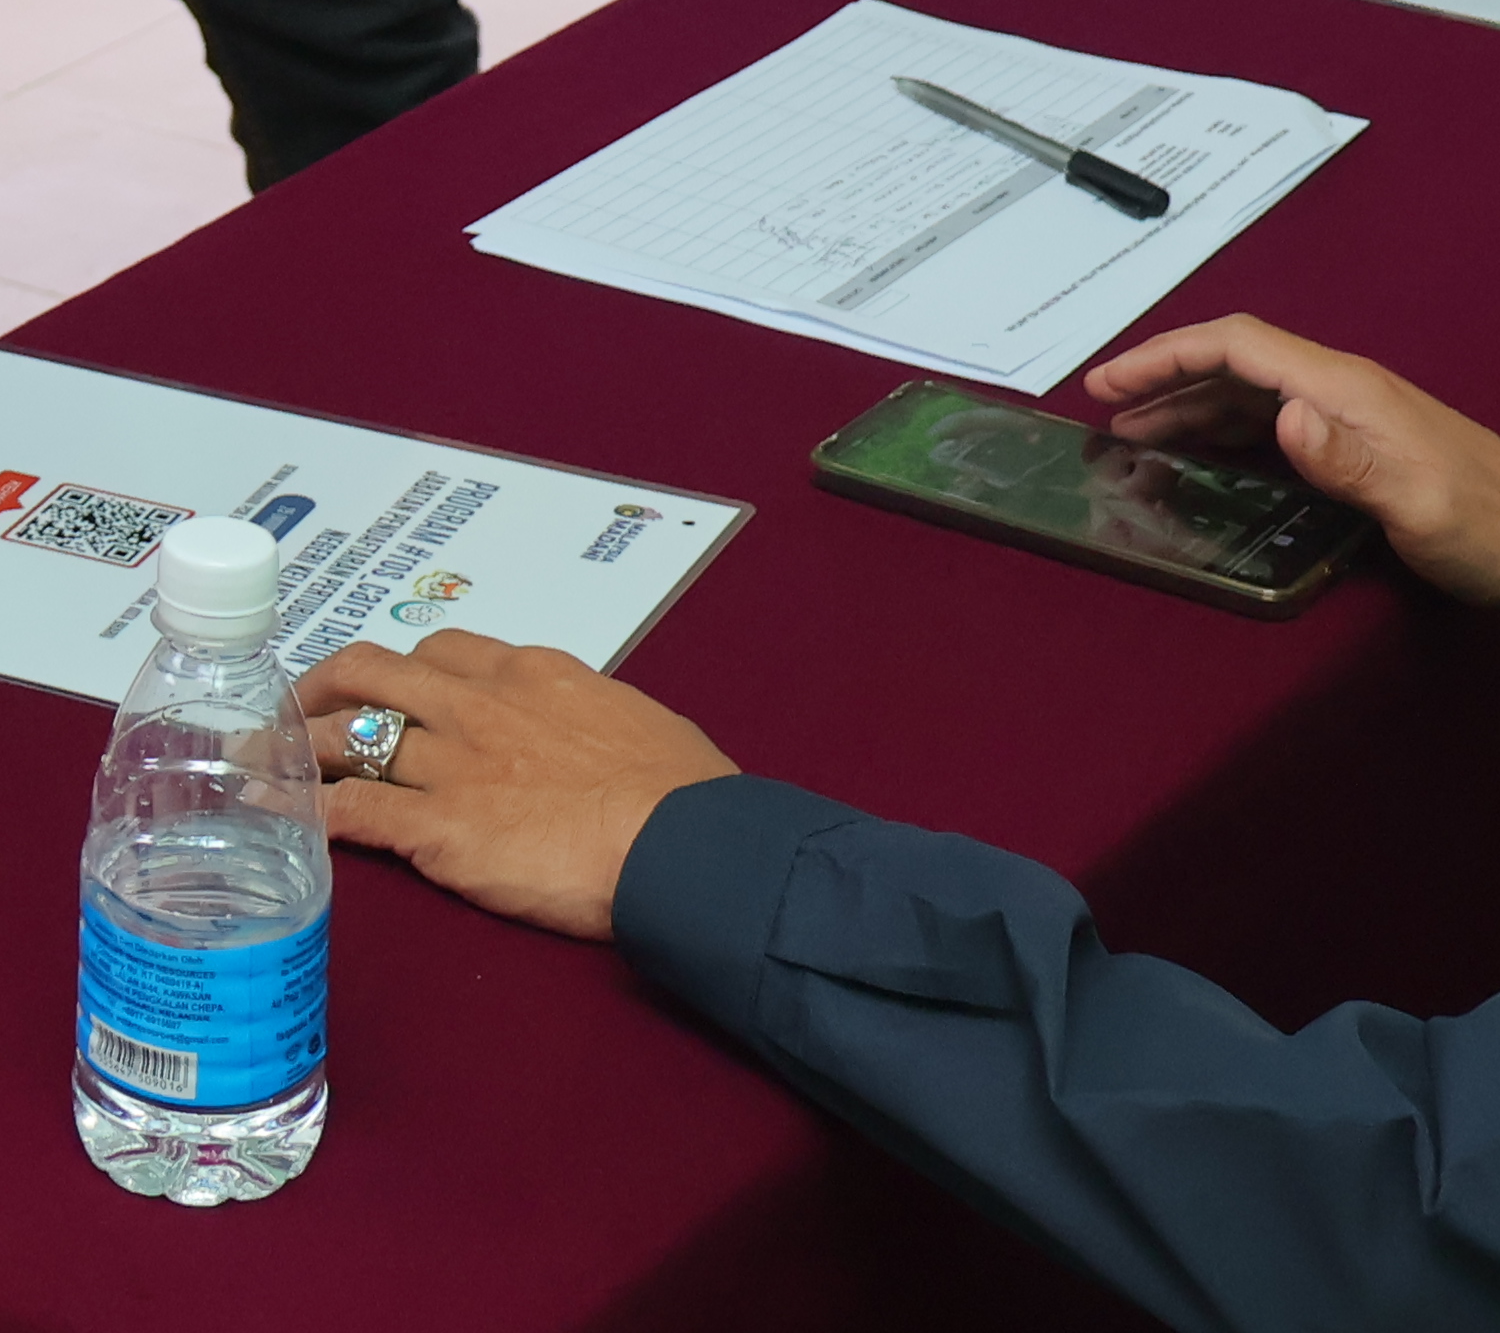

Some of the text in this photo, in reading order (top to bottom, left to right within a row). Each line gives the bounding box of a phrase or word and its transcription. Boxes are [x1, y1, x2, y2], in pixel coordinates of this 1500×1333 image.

[393, 470, 450, 514] JABATAN
[297, 527, 350, 566] NEGERI
[326, 509, 411, 577] PENDAFTARAN
[579, 518, 631, 561] MADANI
[600, 523, 647, 563] MALAYSIA
[284, 478, 500, 668] PROGRAM #ros_care TAHUN
